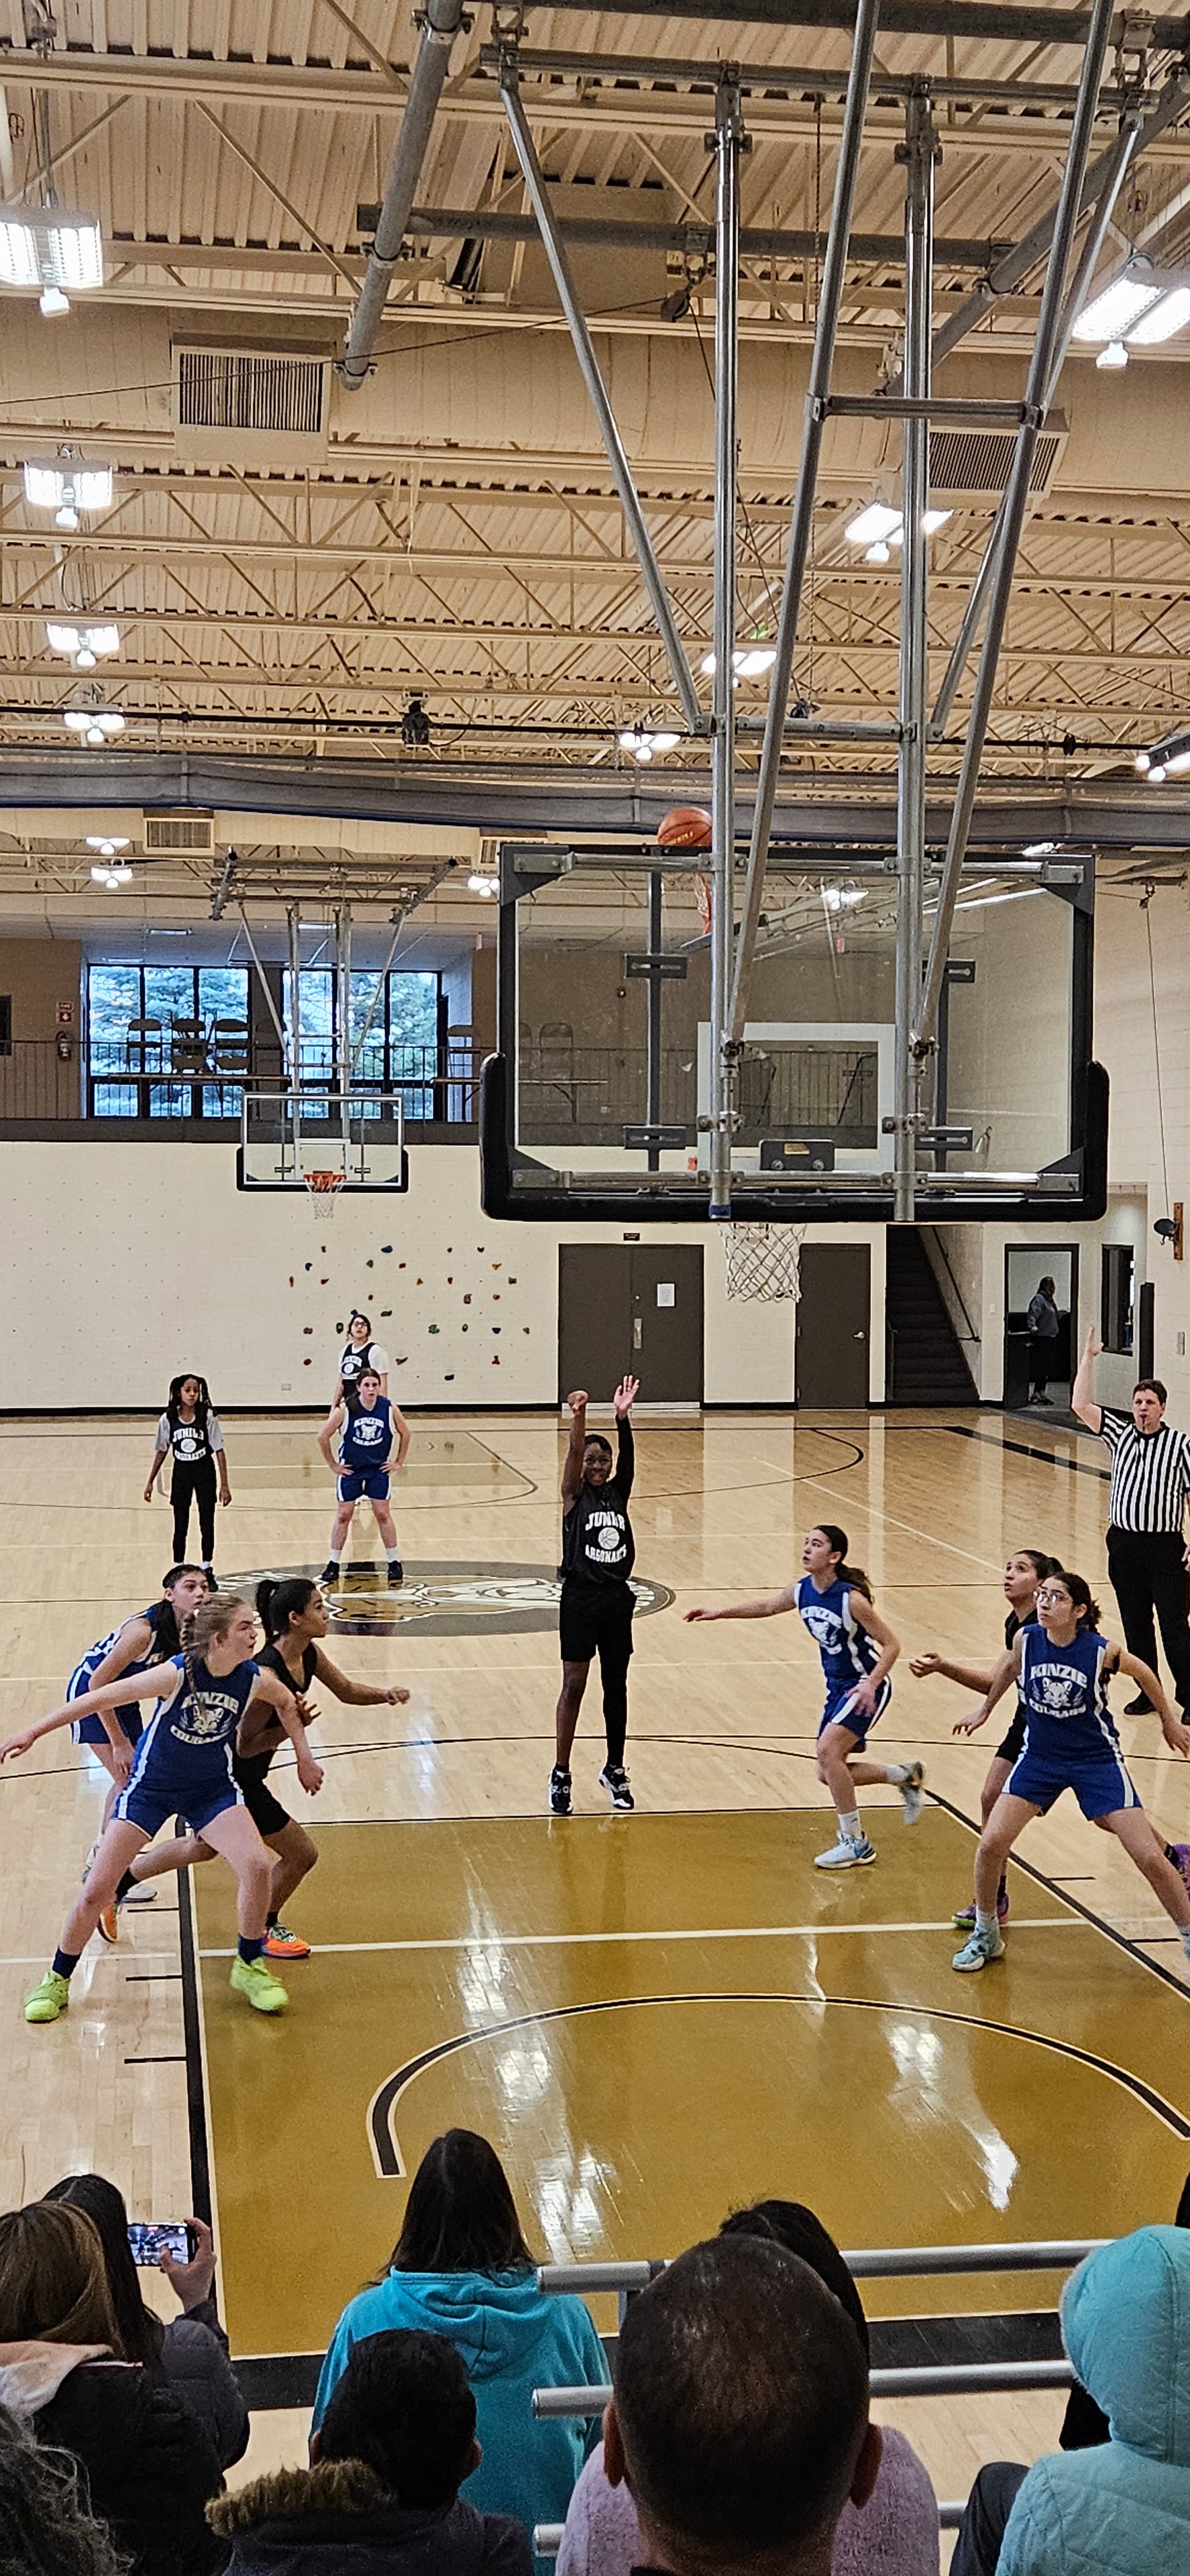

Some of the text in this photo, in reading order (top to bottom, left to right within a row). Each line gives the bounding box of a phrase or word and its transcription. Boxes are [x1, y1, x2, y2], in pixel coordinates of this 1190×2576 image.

[585, 1511, 625, 1532] JUNIR
[1030, 1663, 1087, 1689] KINZIE
[170, 1725, 231, 1744] COUG
